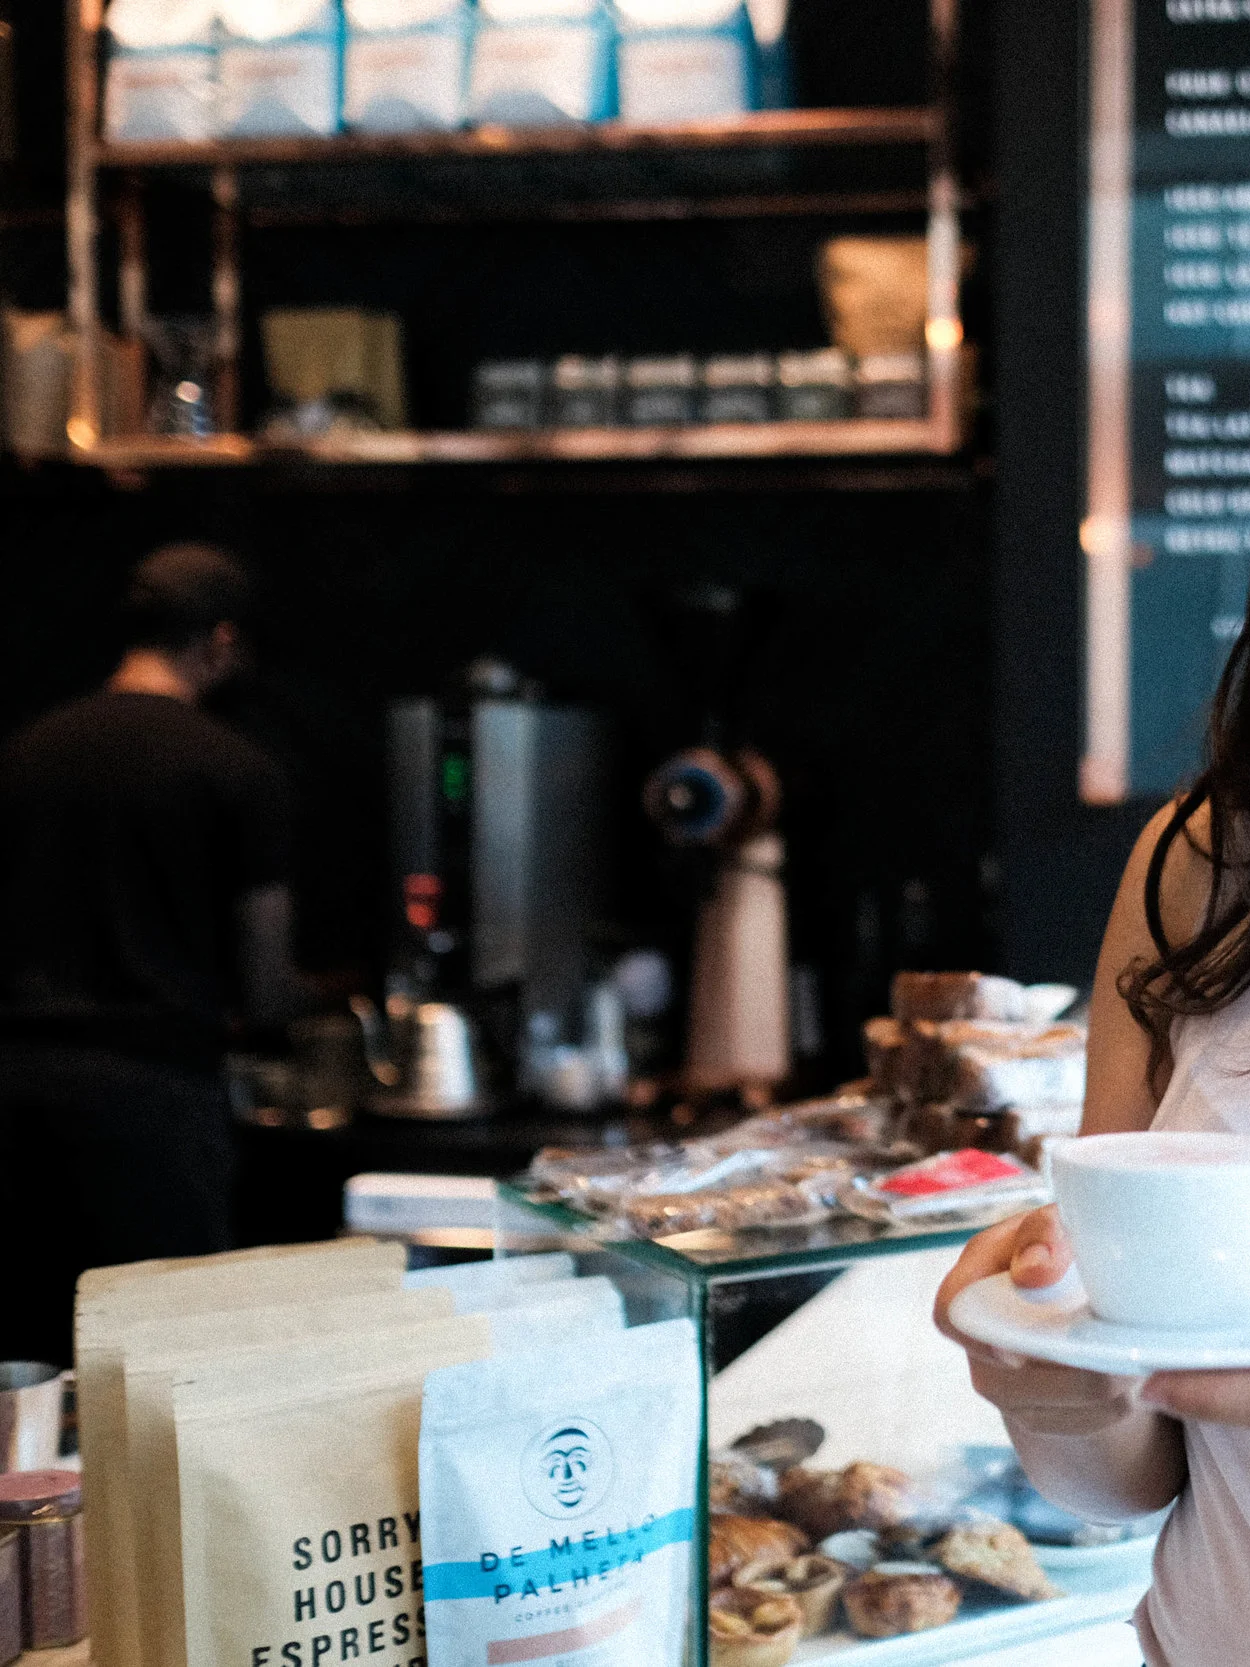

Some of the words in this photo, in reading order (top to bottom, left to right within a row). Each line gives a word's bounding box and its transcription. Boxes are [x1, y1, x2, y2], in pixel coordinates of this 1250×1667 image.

[292, 1510, 421, 1571] SORRY
[478, 1545, 526, 1573] DE
[548, 1512, 657, 1560] MELLO
[294, 1559, 424, 1622] HOUSE
